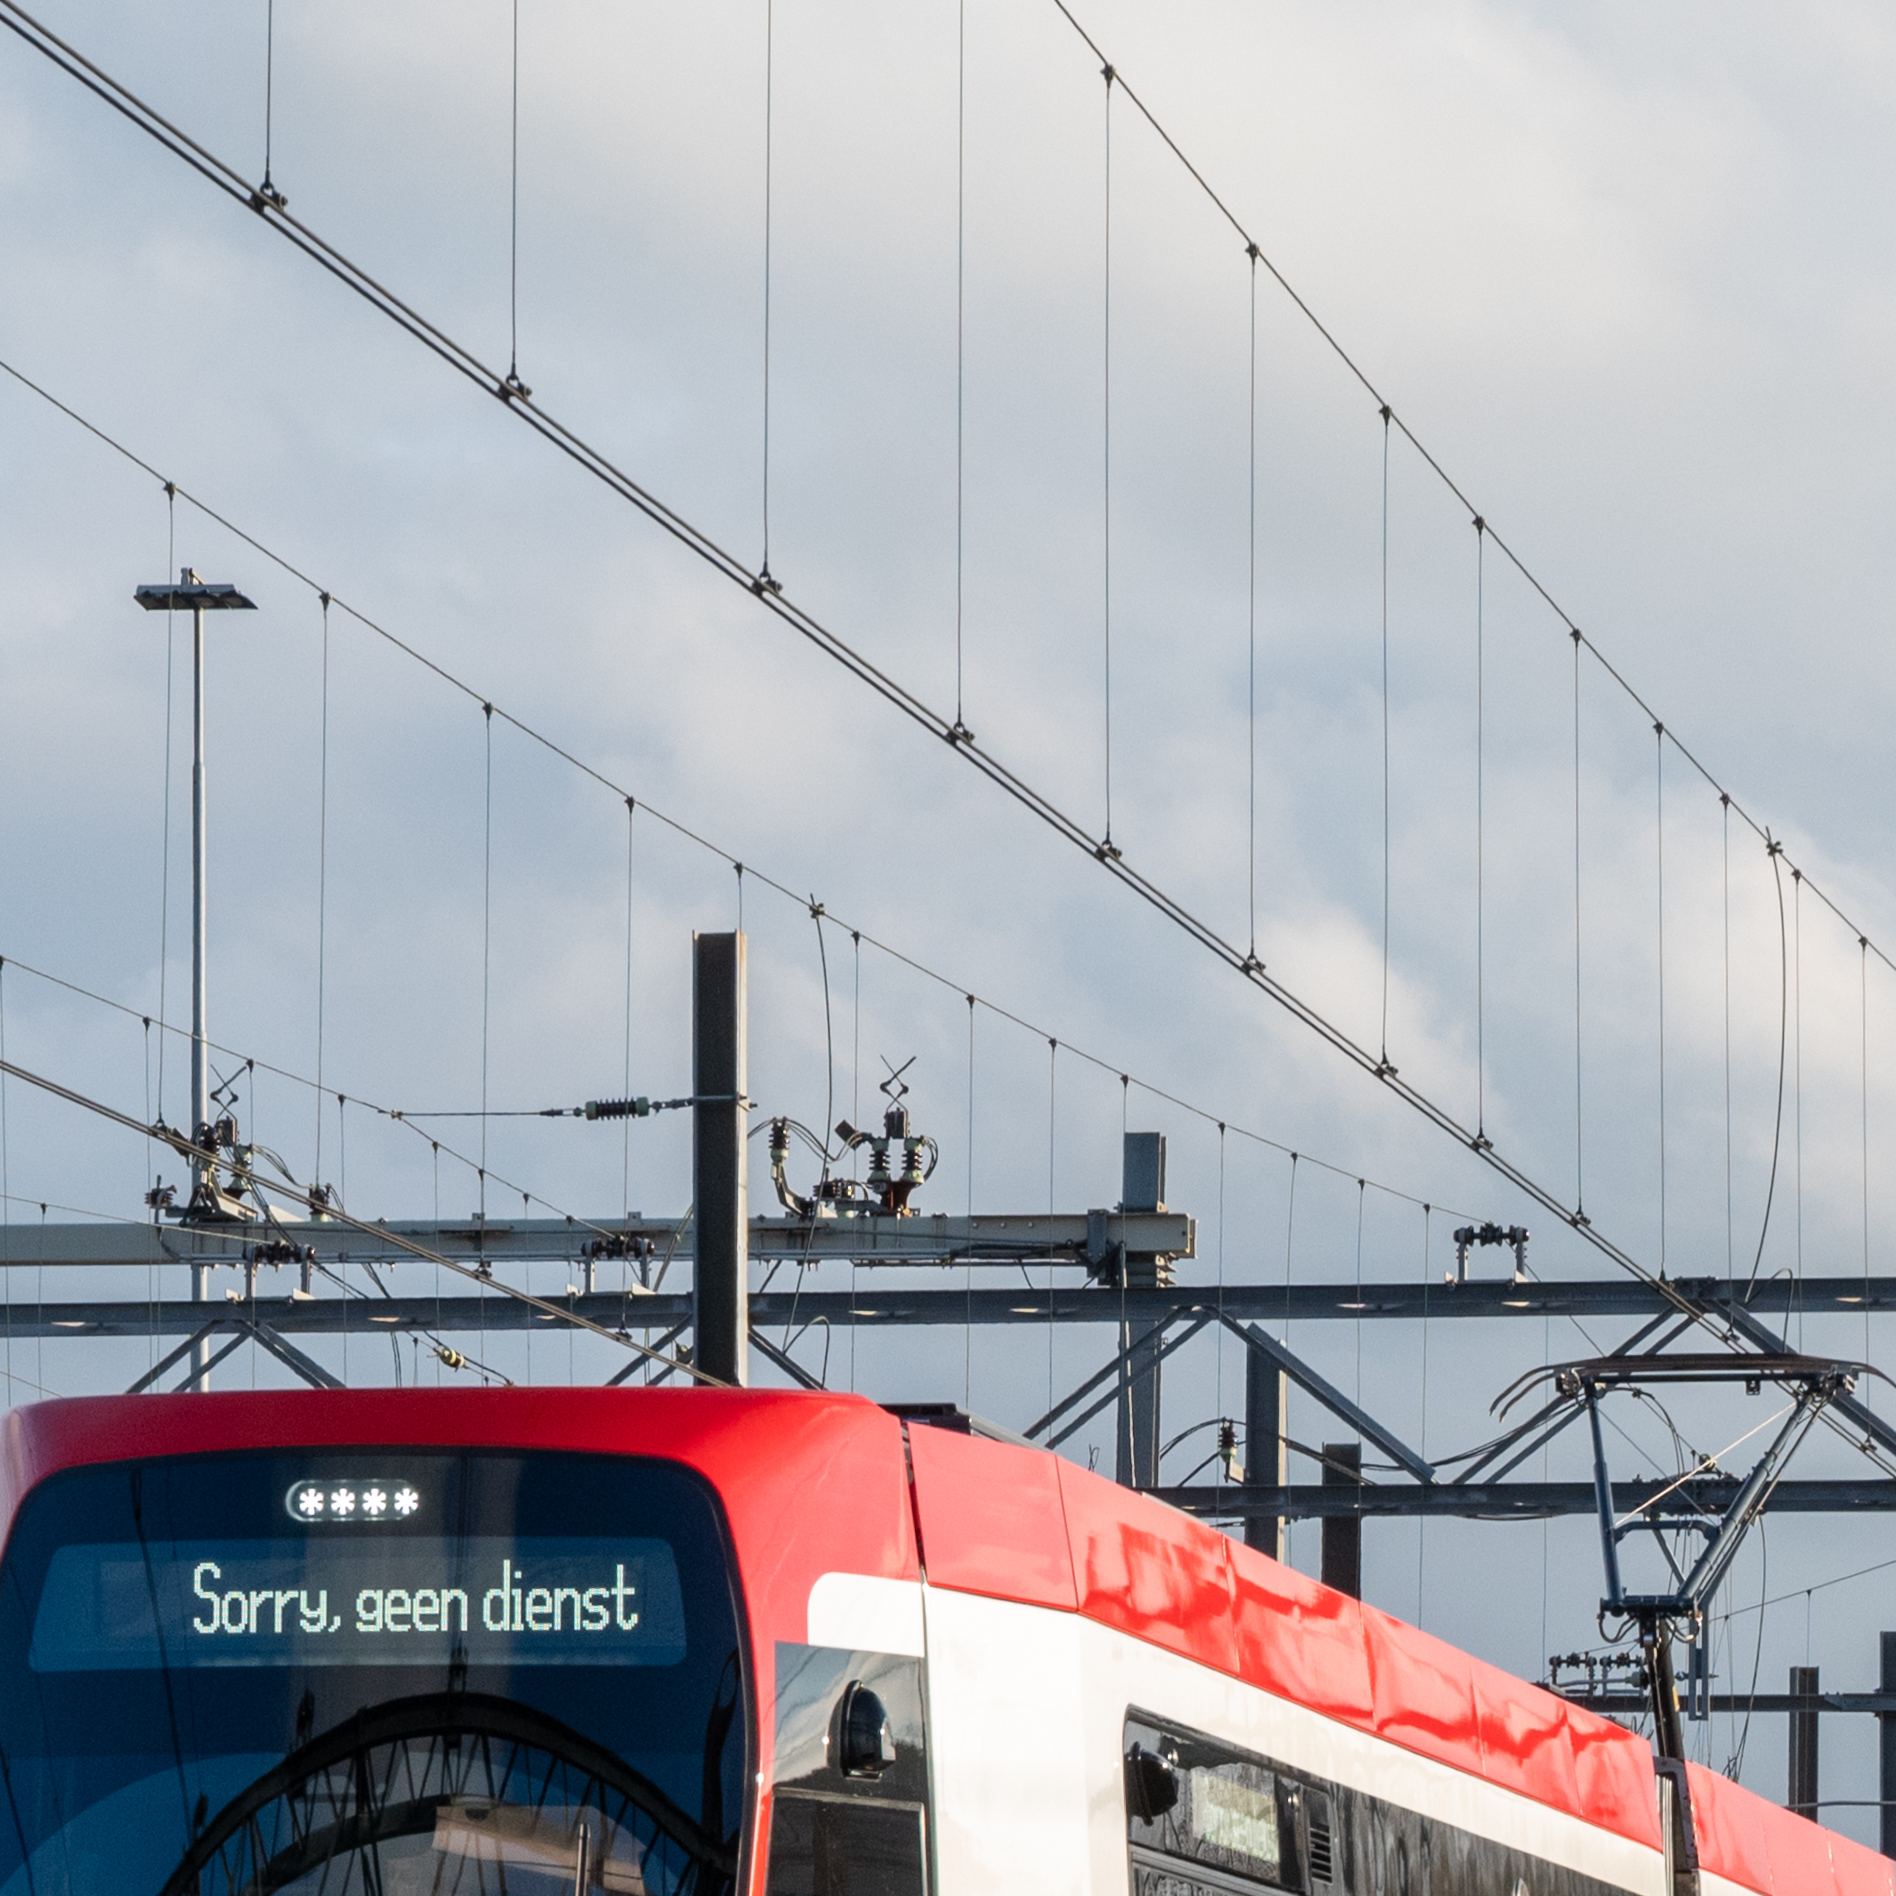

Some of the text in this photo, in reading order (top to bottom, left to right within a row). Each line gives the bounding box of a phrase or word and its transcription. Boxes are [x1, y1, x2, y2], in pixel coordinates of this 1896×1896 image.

[193, 1560, 638, 1633] Sorry, geen dienst
